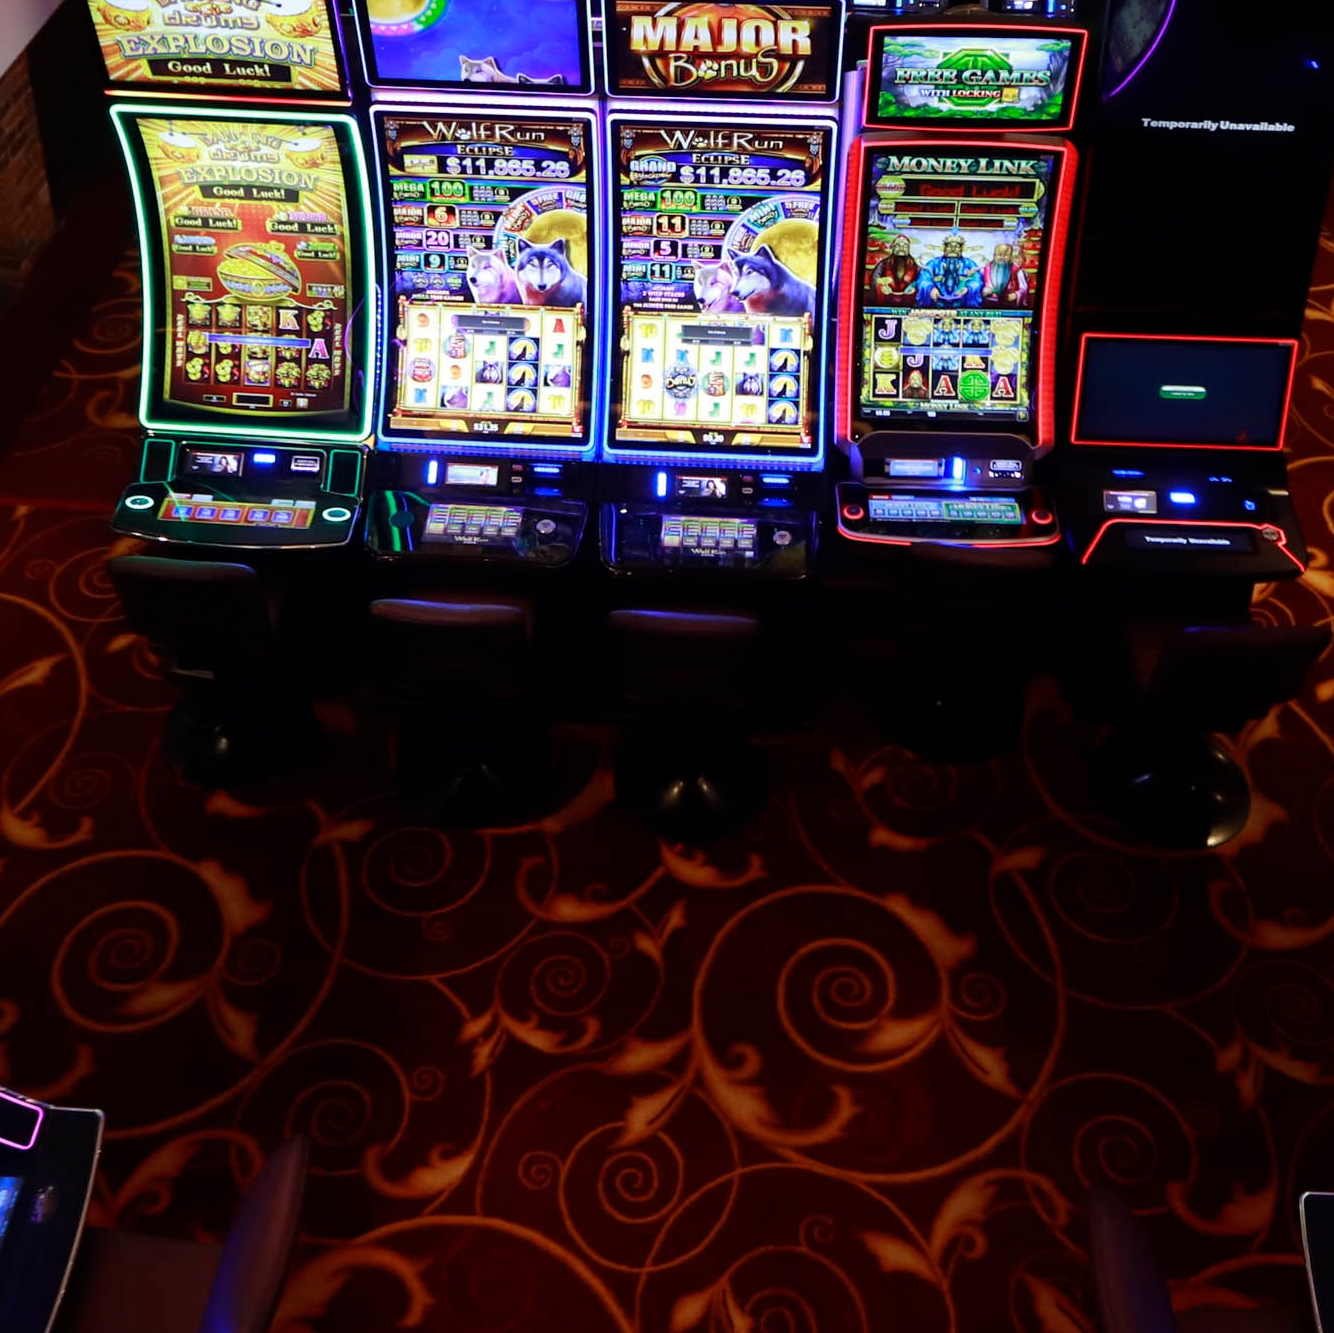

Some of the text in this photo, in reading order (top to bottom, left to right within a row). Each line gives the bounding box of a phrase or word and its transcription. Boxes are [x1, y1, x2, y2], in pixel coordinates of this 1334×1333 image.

[630, 15, 812, 55] MAJOR
[119, 33, 315, 66] EXPLOSION
[168, 61, 270, 77] Good Luck!
[668, 46, 778, 86] Bonus
[895, 68, 1051, 86] FREE GAMES
[921, 89, 1001, 98] WITH LOCKING
[1141, 118, 1295, 132] Temporarily Unavailable
[456, 144, 514, 156] ECLIPSE
[630, 161, 676, 172] GRAND
[692, 153, 750, 165] ECLIPSE
[887, 155, 1038, 175] MONEY LINK
[178, 167, 317, 190] EXPLOSION
[213, 186, 285, 199] Good Luck!
[393, 183, 424, 192] MEGA
[431, 181, 463, 197] 100
[921, 184, 1021, 197] Good Luck!
[623, 192, 655, 201] MEGA
[662, 191, 695, 206] 100
[394, 207, 423, 216] MAJOR
[434, 207, 448, 223] 6
[175, 217, 237, 229] Good Luck!
[269, 222, 338, 234] Good Luck!
[622, 217, 651, 226] MAJOR
[658, 216, 682, 232] 11
[427, 231, 449, 246] 20
[660, 241, 671, 255] 5
[396, 254, 420, 262] MINI
[429, 254, 441, 268] 9
[650, 264, 671, 278] 11
[278, 309, 300, 330] K
[878, 319, 898, 340] J
[308, 338, 330, 359] A
[875, 373, 897, 395] K
[934, 375, 956, 396] A
[992, 376, 1014, 398] A
